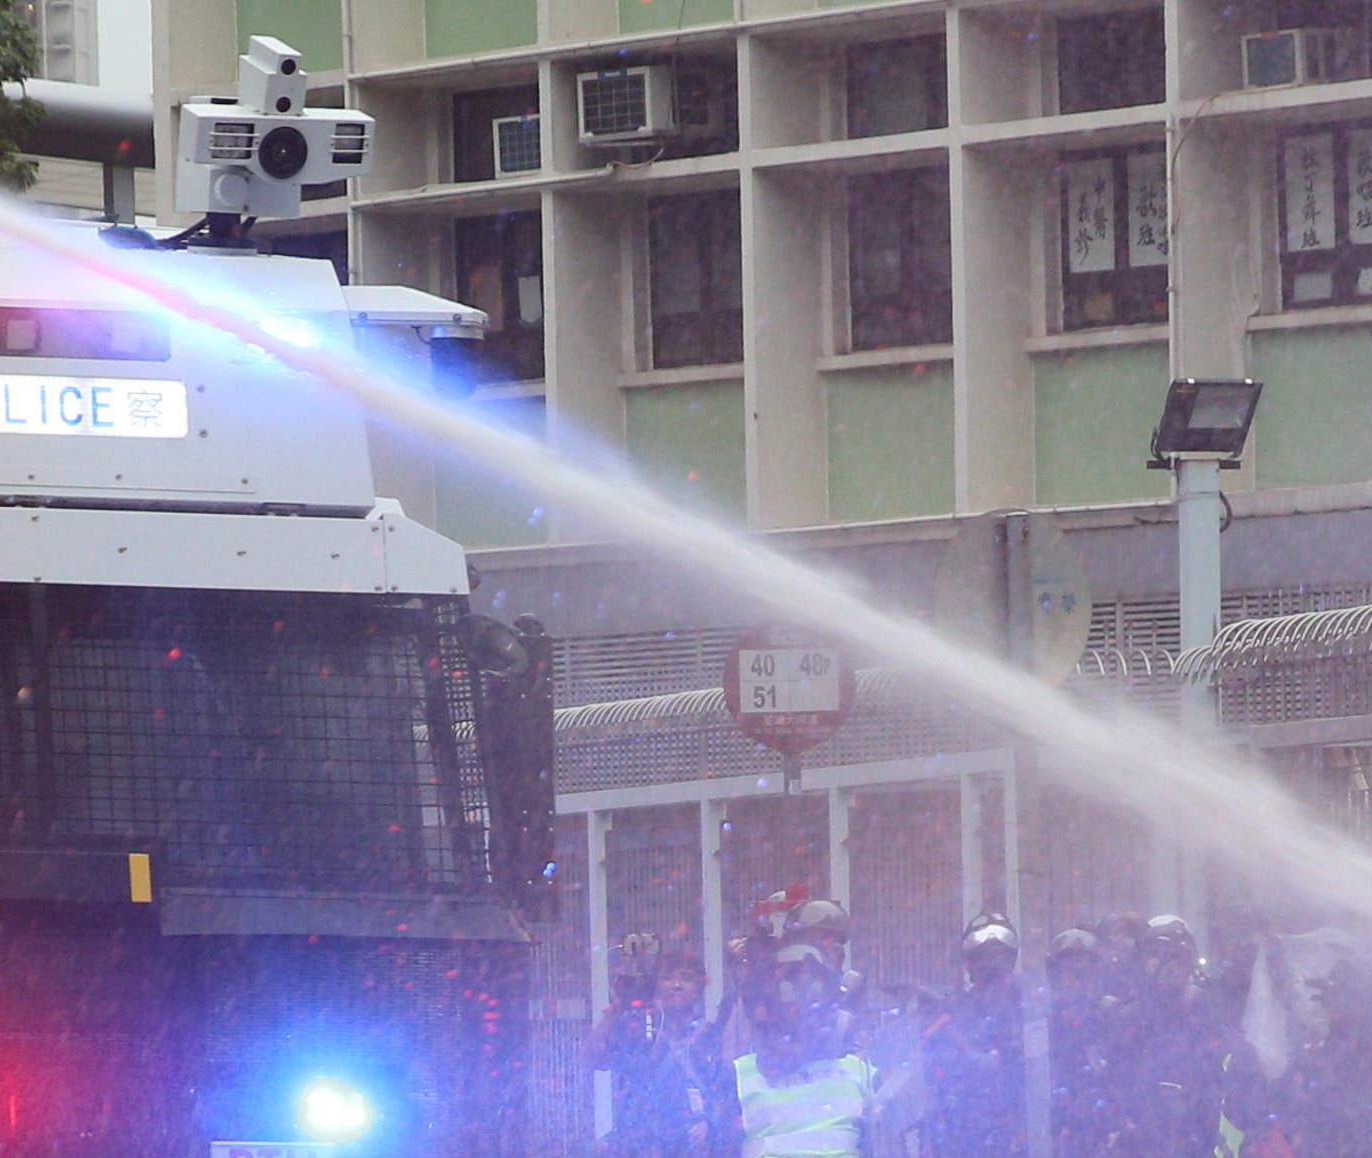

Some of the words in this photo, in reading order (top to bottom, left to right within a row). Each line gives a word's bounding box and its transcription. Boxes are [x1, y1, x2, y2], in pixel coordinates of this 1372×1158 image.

[127, 388, 164, 429] 察
[750, 653, 776, 678] 40
[753, 684, 777, 709] 51
